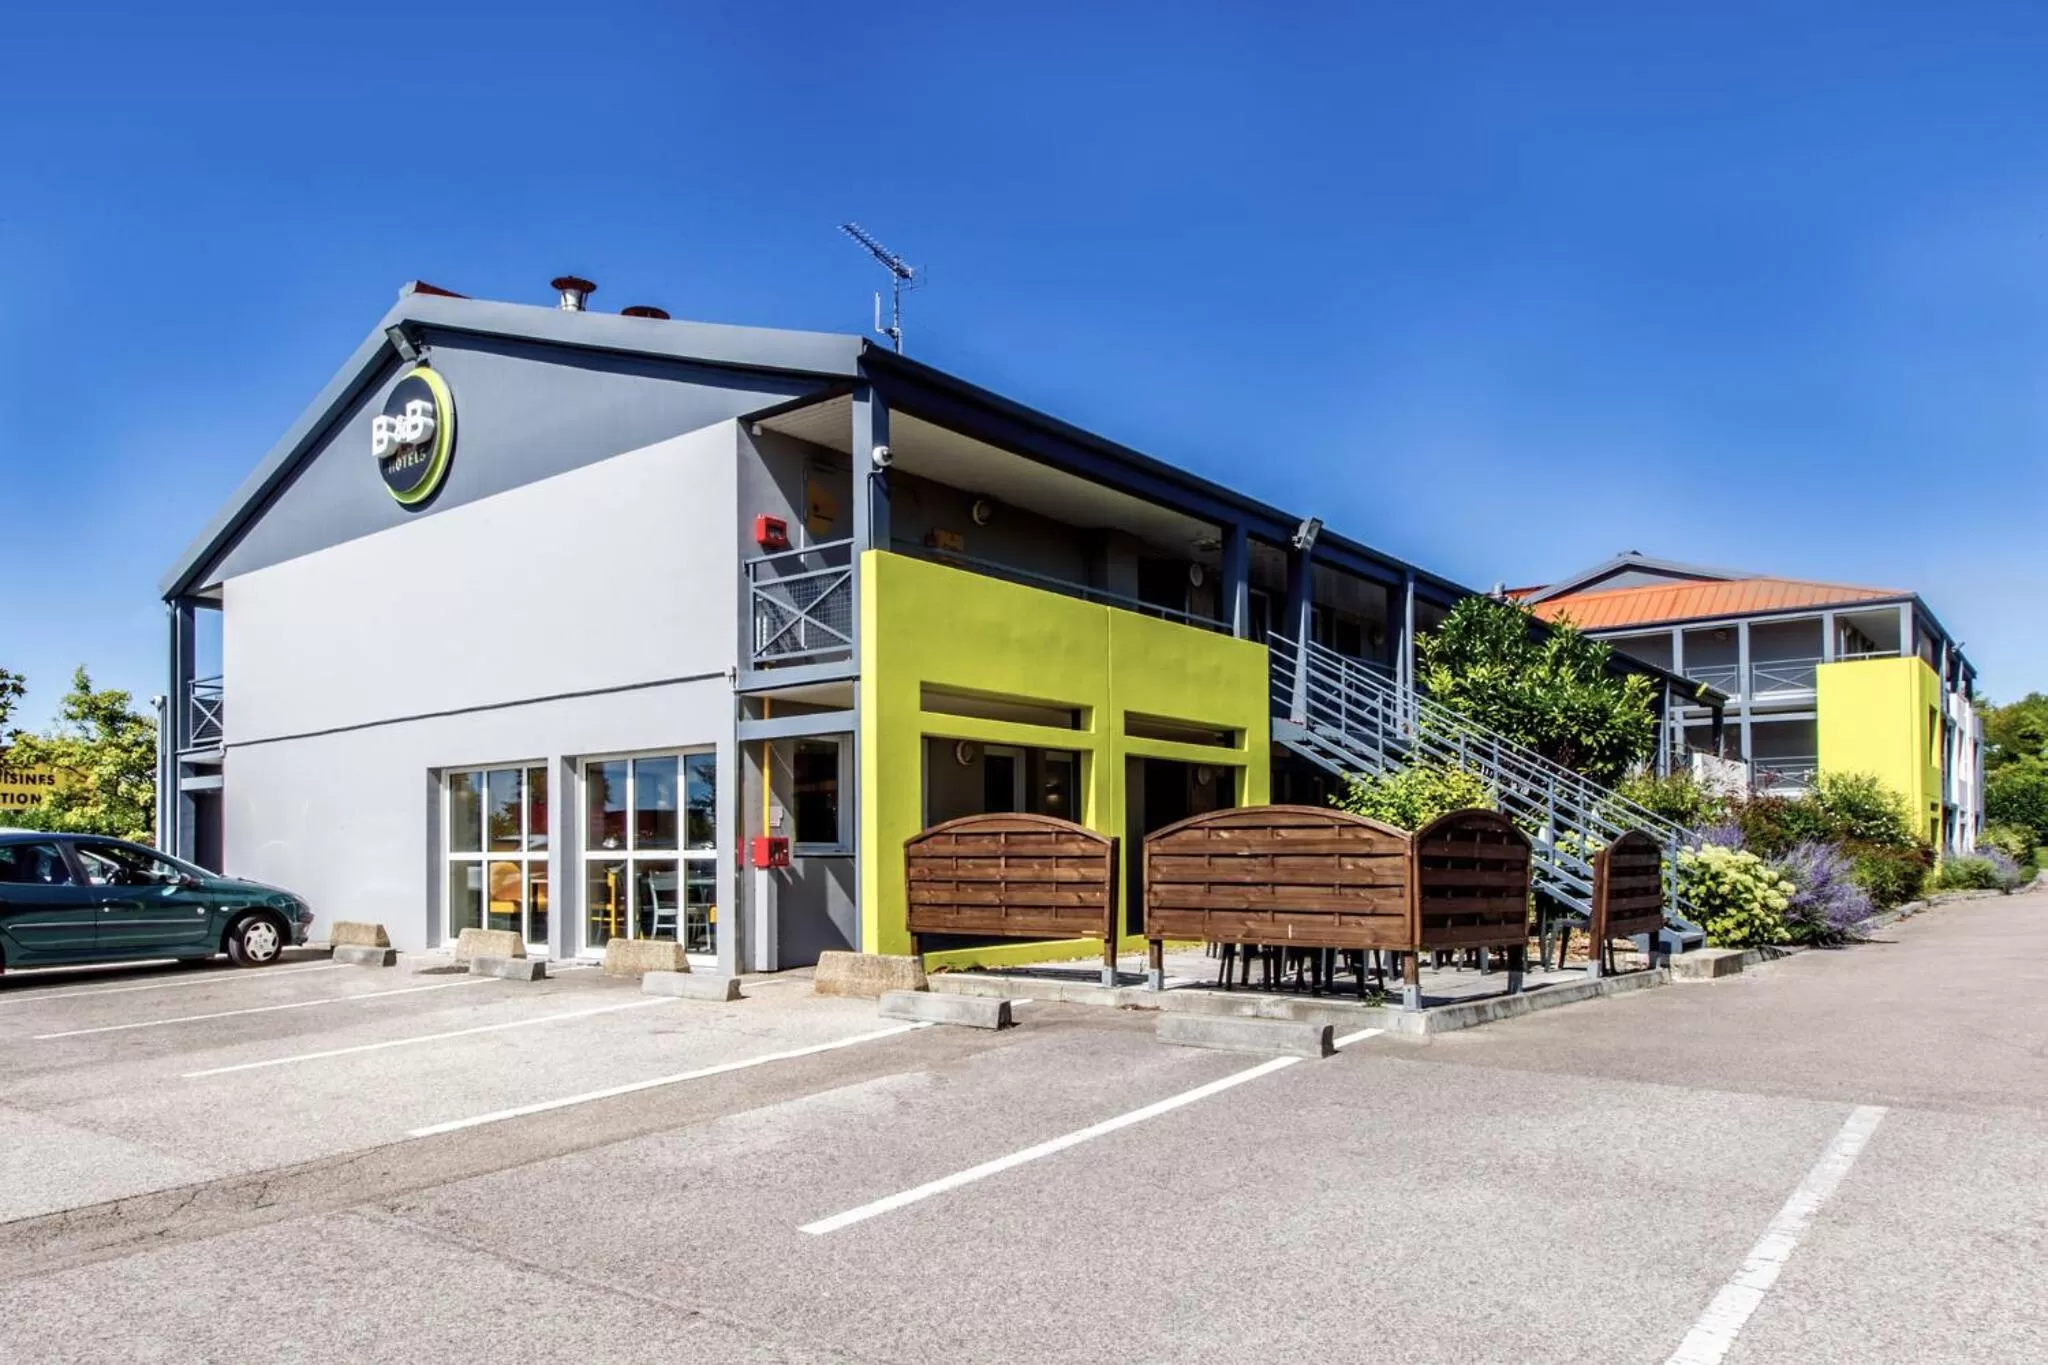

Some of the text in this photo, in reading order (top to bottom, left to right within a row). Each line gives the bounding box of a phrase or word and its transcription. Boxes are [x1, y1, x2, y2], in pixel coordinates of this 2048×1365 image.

[388, 448, 427, 474] HOTELS
[0, 773, 55, 785] ISINES
[1, 793, 42, 804] TION
